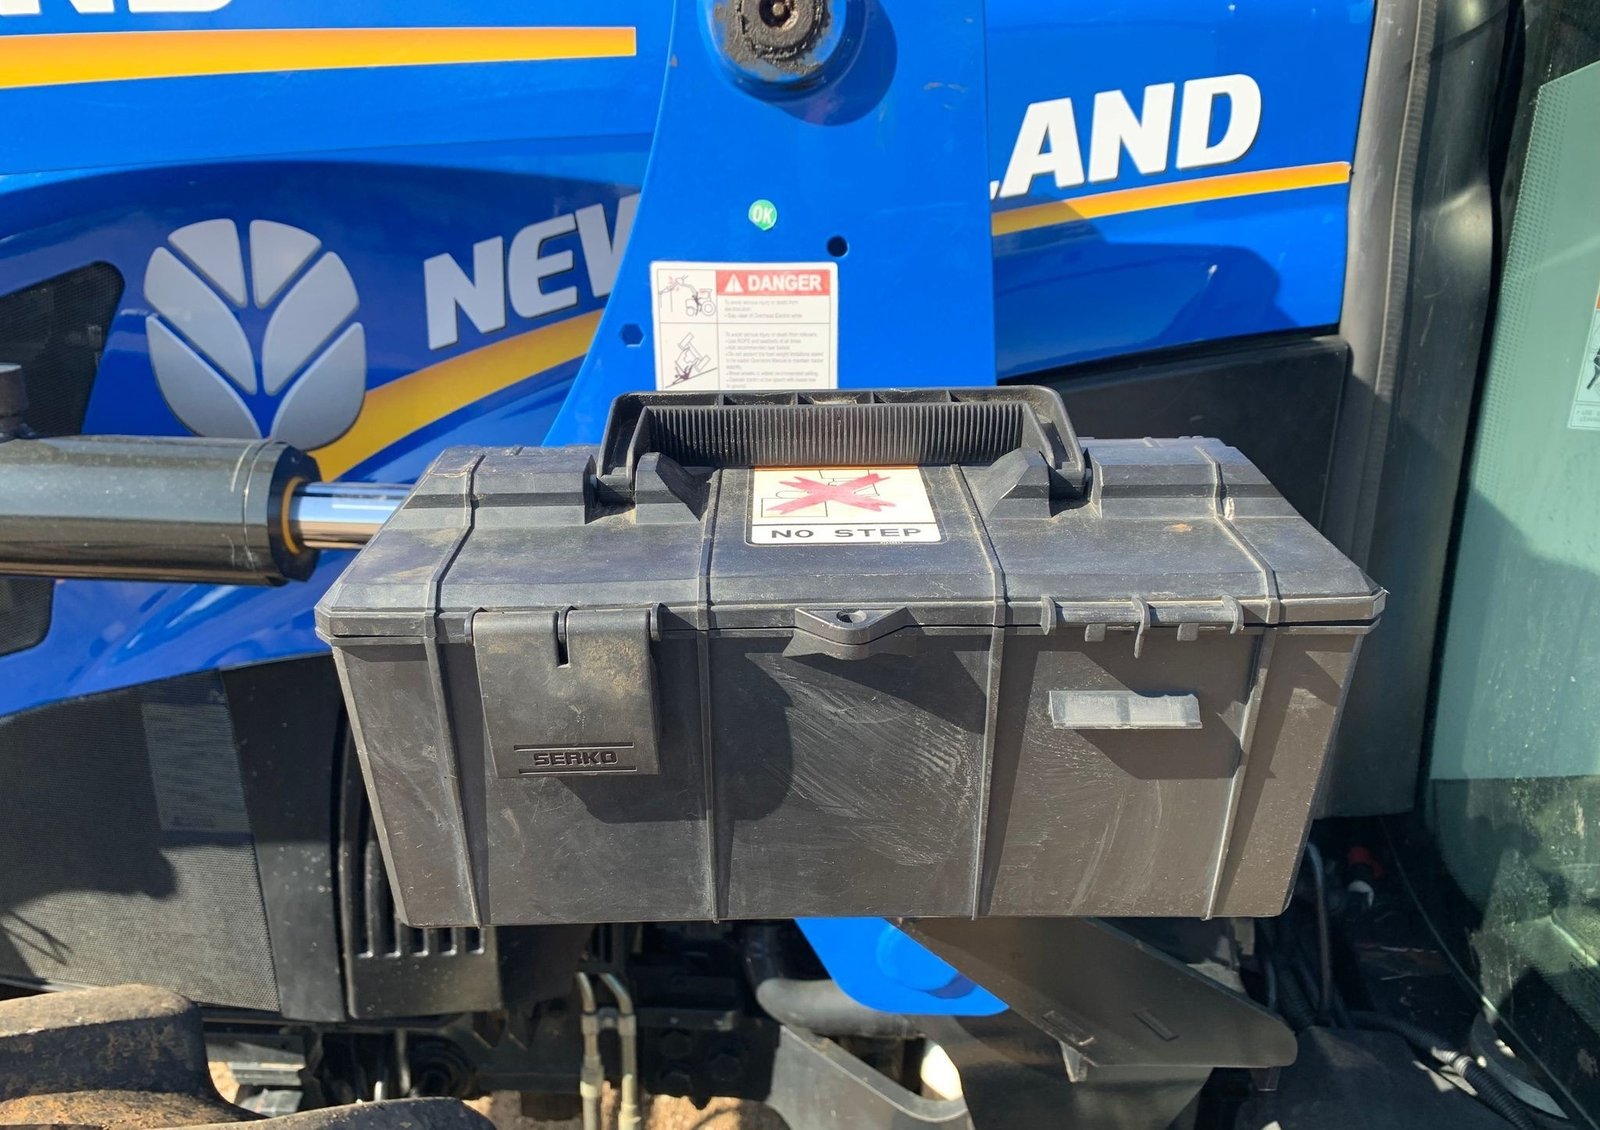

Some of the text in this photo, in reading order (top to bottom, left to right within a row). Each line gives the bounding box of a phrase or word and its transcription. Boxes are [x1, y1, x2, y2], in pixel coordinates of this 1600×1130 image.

[990, 74, 1262, 200] AND
[752, 204, 774, 223] OK
[747, 274, 823, 292] DANGER
[771, 528, 922, 538] NO STEP
[533, 750, 618, 767] SERKO
